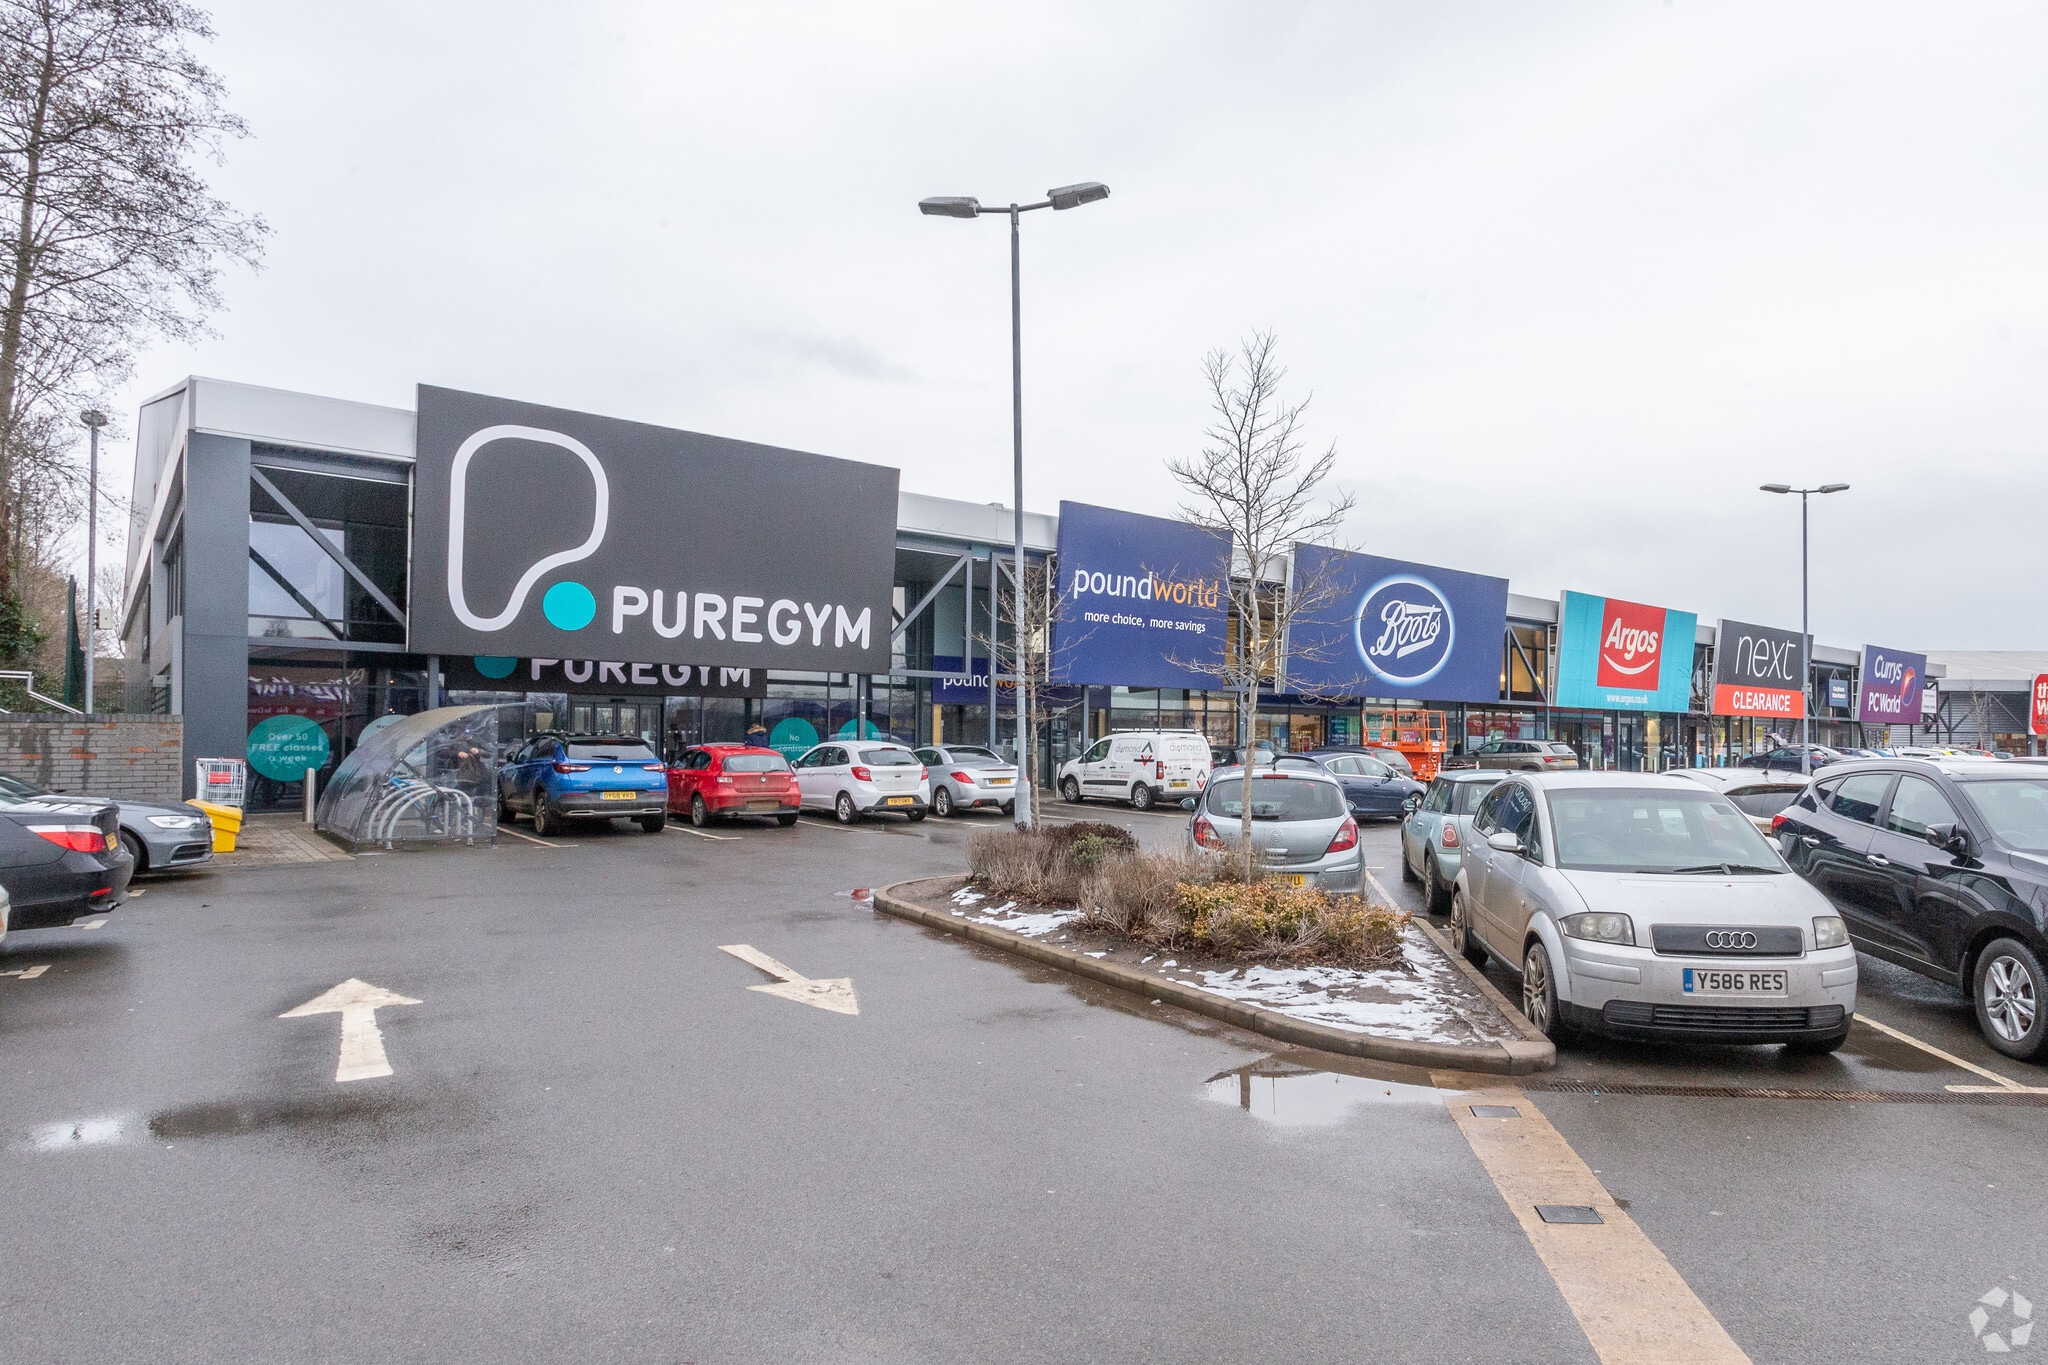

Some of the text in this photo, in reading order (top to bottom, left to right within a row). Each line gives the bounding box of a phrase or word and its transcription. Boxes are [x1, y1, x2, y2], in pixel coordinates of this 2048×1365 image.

[1073, 569, 1218, 608] poundworld
[612, 585, 872, 651] PUREGYM
[1084, 612, 1206, 634] more choice, more savings
[1369, 600, 1442, 659] Boots
[1605, 618, 1658, 660] Argos
[1736, 636, 1796, 680] next
[1875, 655, 1902, 683] Currys
[530, 659, 750, 688] PUREGYM
[1607, 694, 1648, 705] www.argos.co.uk
[1734, 691, 1790, 711] CLEARANCE
[1868, 692, 1878, 712] PC
[1881, 693, 1901, 713] World
[268, 733, 308, 741] Over 50
[789, 734, 800, 742] No
[1697, 973, 1783, 990] Y586 RES
